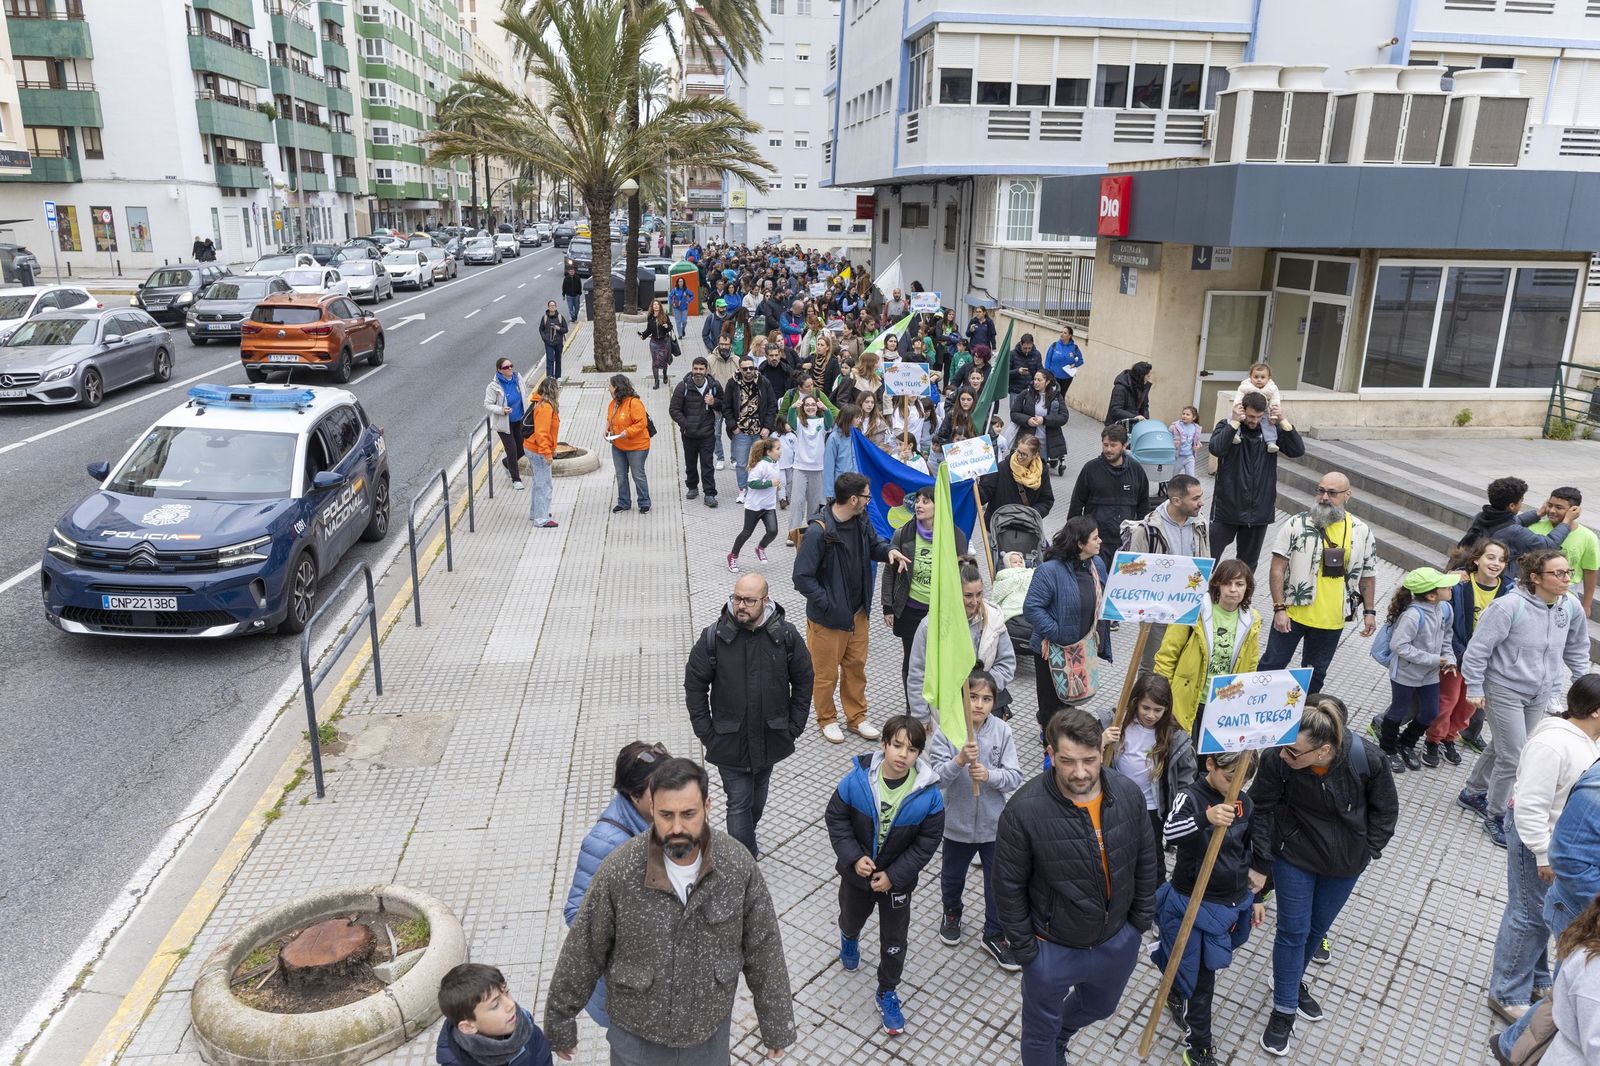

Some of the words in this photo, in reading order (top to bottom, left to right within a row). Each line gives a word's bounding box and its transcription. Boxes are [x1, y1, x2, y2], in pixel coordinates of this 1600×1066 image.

[1112, 254, 1149, 266] SUPERMERCADO
[322, 484, 356, 525] POLICIA
[324, 494, 363, 541] NACIONAL
[100, 530, 180, 541] POLICIA
[1151, 573, 1172, 583] CEIP
[1110, 587, 1165, 602] CELESTINO
[1167, 592, 1204, 604] MUTIS
[110, 597, 176, 610] CNP2213BC
[1247, 693, 1268, 706] CEIP
[1217, 712, 1251, 728] SANTA
[1255, 708, 1292, 725] TERESA
